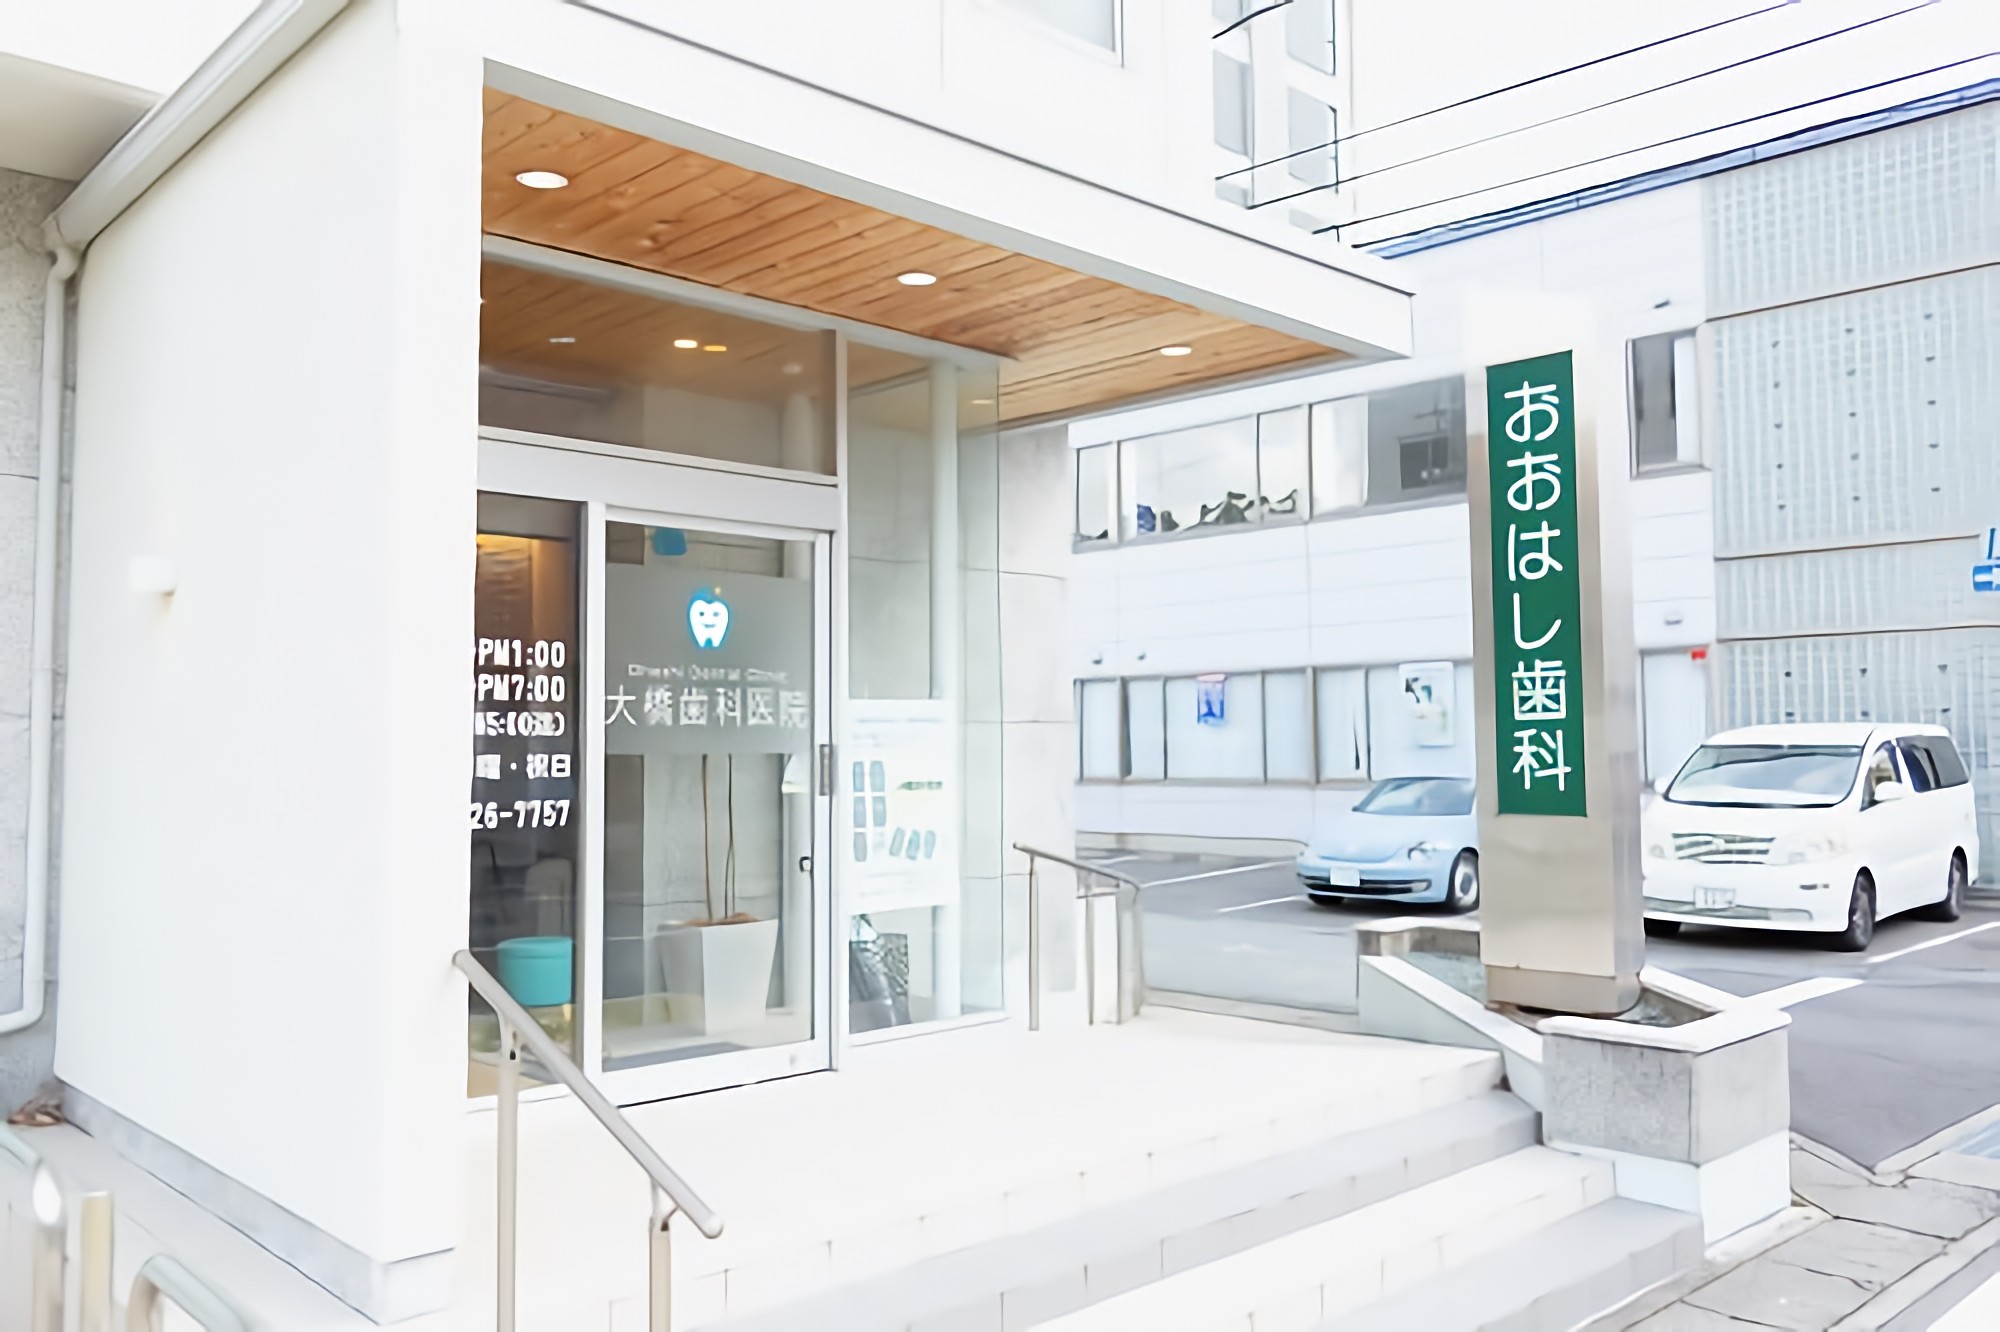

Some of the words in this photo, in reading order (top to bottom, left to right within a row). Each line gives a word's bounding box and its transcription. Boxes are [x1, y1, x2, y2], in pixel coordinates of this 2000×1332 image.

[1503, 380, 1572, 792] おおはし歯科
